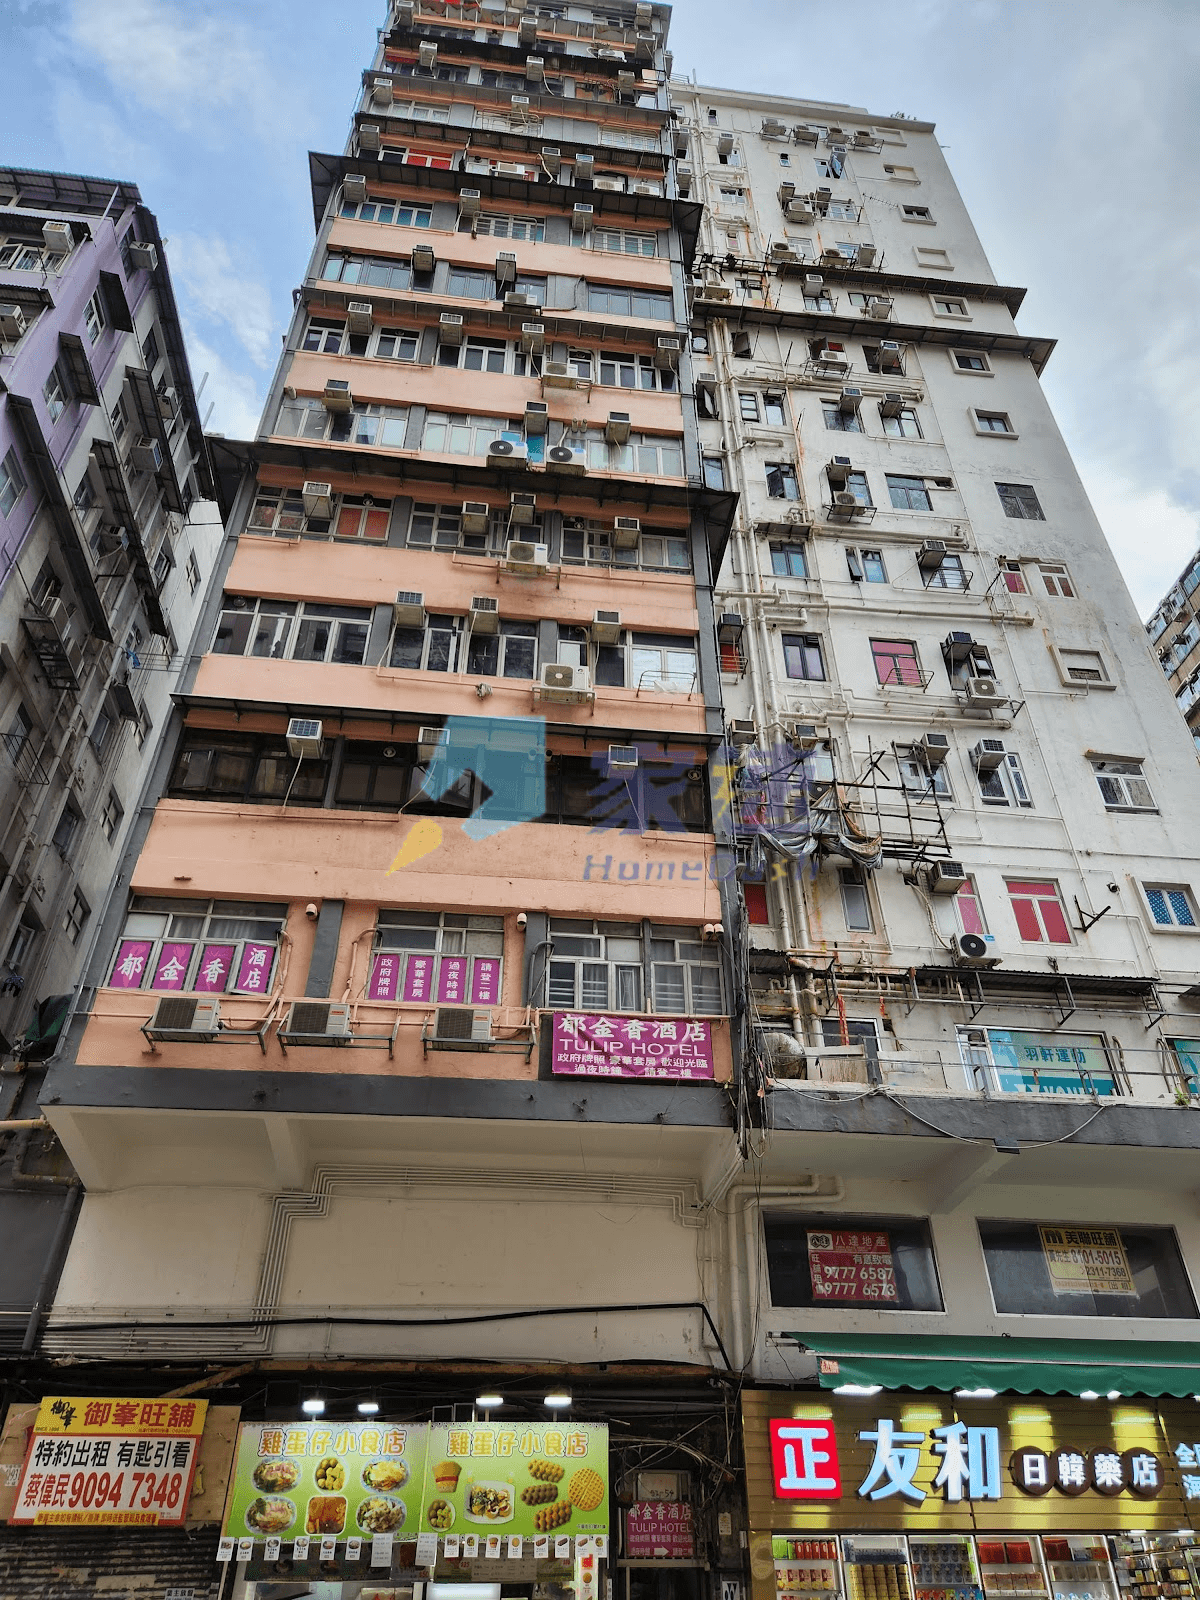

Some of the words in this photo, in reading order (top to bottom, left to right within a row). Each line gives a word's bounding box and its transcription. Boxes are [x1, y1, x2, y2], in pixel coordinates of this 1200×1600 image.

[117, 947, 268, 990] 郁金香酒店
[377, 958, 394, 996] 政府牌照
[557, 1013, 706, 1042] 郁金香酒店
[557, 1053, 605, 1065] 政府牌照
[559, 1038, 624, 1054] TULIP
[631, 1042, 706, 1057] HOTEL
[823, 1266, 857, 1279] 9777
[860, 1267, 894, 1280] 6587
[824, 1282, 857, 1295] 9777
[862, 1283, 896, 1297] 6573
[35, 1439, 111, 1467] 特約出租
[116, 1440, 191, 1469] 有匙引看
[258, 1429, 406, 1456] 雞蛋仔小食店
[448, 1430, 588, 1457] 雞蛋仔小食店
[777, 1426, 837, 1490] 正
[857, 1418, 1002, 1502] 友和
[1022, 1453, 1158, 1487] 日韓藥店
[23, 1473, 71, 1508] 蔡偉民
[68, 1472, 125, 1509] 9094
[128, 1472, 183, 1509] 7348
[628, 1502, 692, 1521] 郁金香酒店
[630, 1522, 657, 1533] TULIP
[660, 1522, 691, 1533] HOTEL
